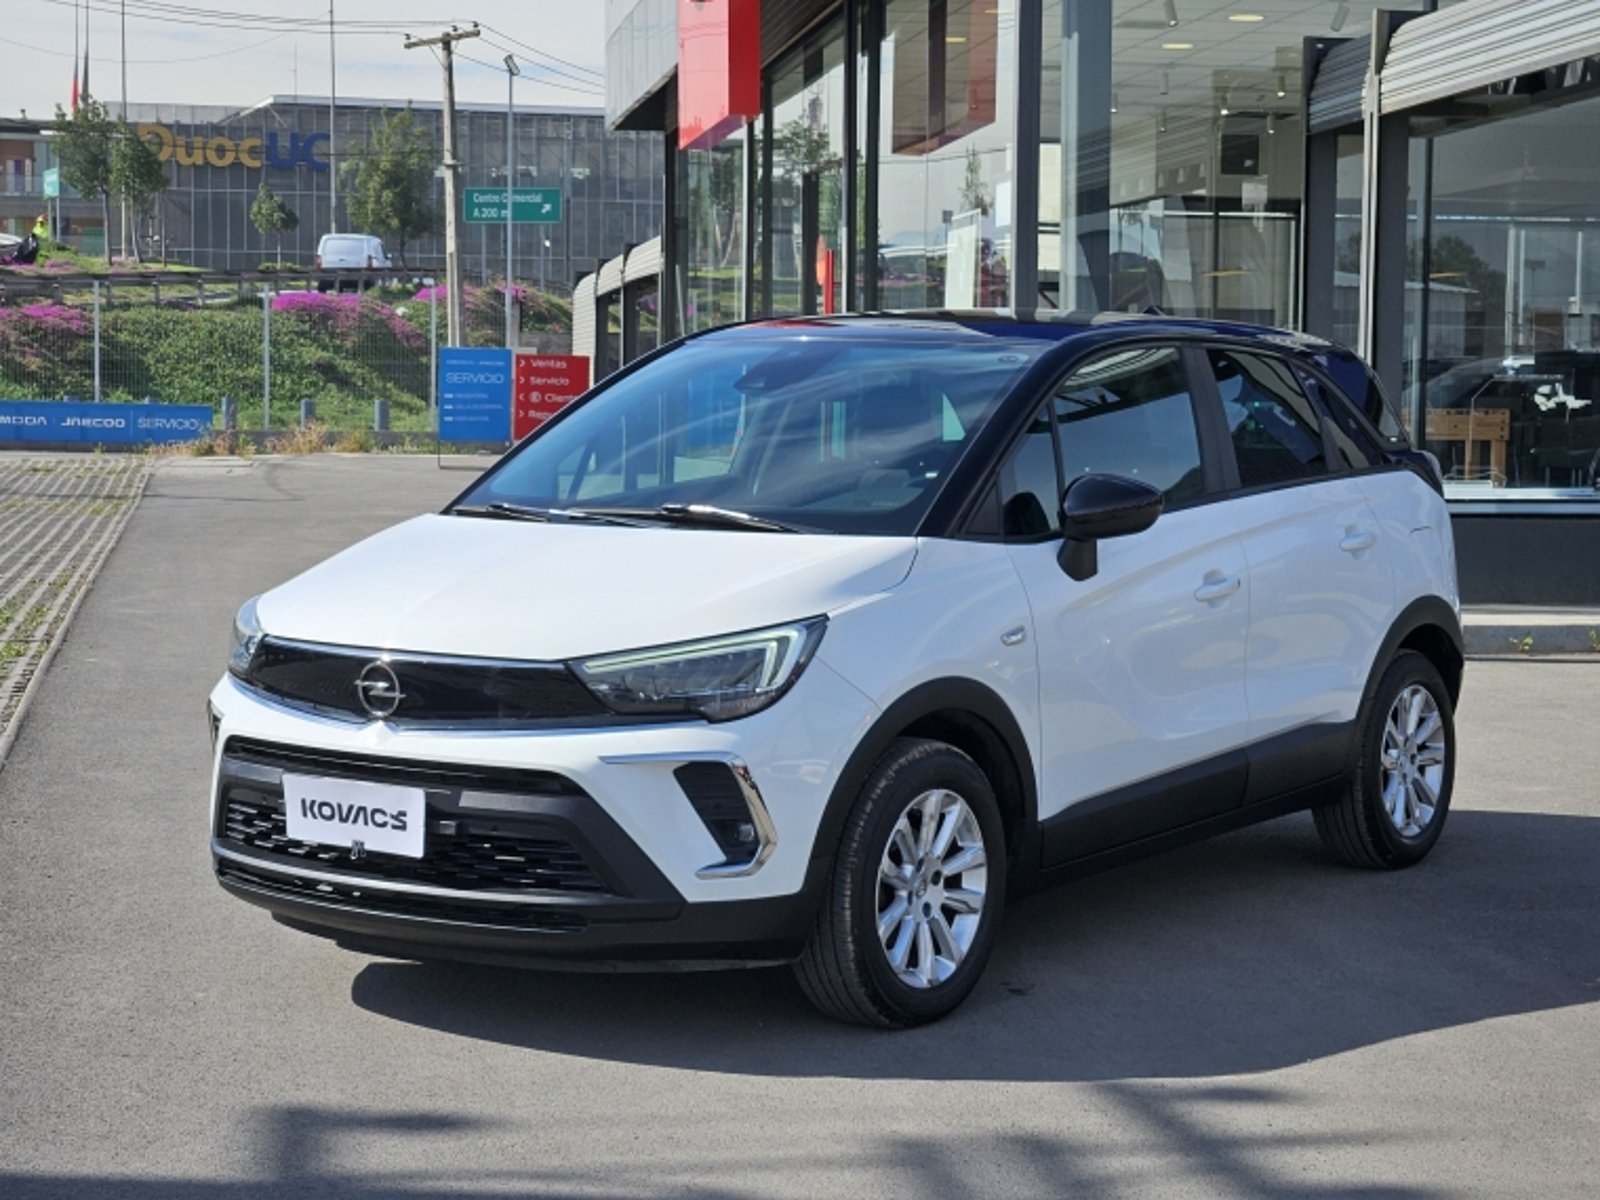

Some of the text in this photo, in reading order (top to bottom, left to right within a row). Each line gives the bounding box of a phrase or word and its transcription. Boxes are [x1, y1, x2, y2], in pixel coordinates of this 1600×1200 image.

[501, 193, 542, 203] Cmercial
[473, 208, 480, 218] A
[481, 208, 498, 218] 200
[530, 358, 567, 369] Ventas
[446, 372, 504, 385] SERVICIO
[529, 376, 570, 386] Servicio
[61, 416, 125, 428] JAECOO
[138, 417, 199, 430] SERVICIO
[300, 797, 408, 832] KOVACS
